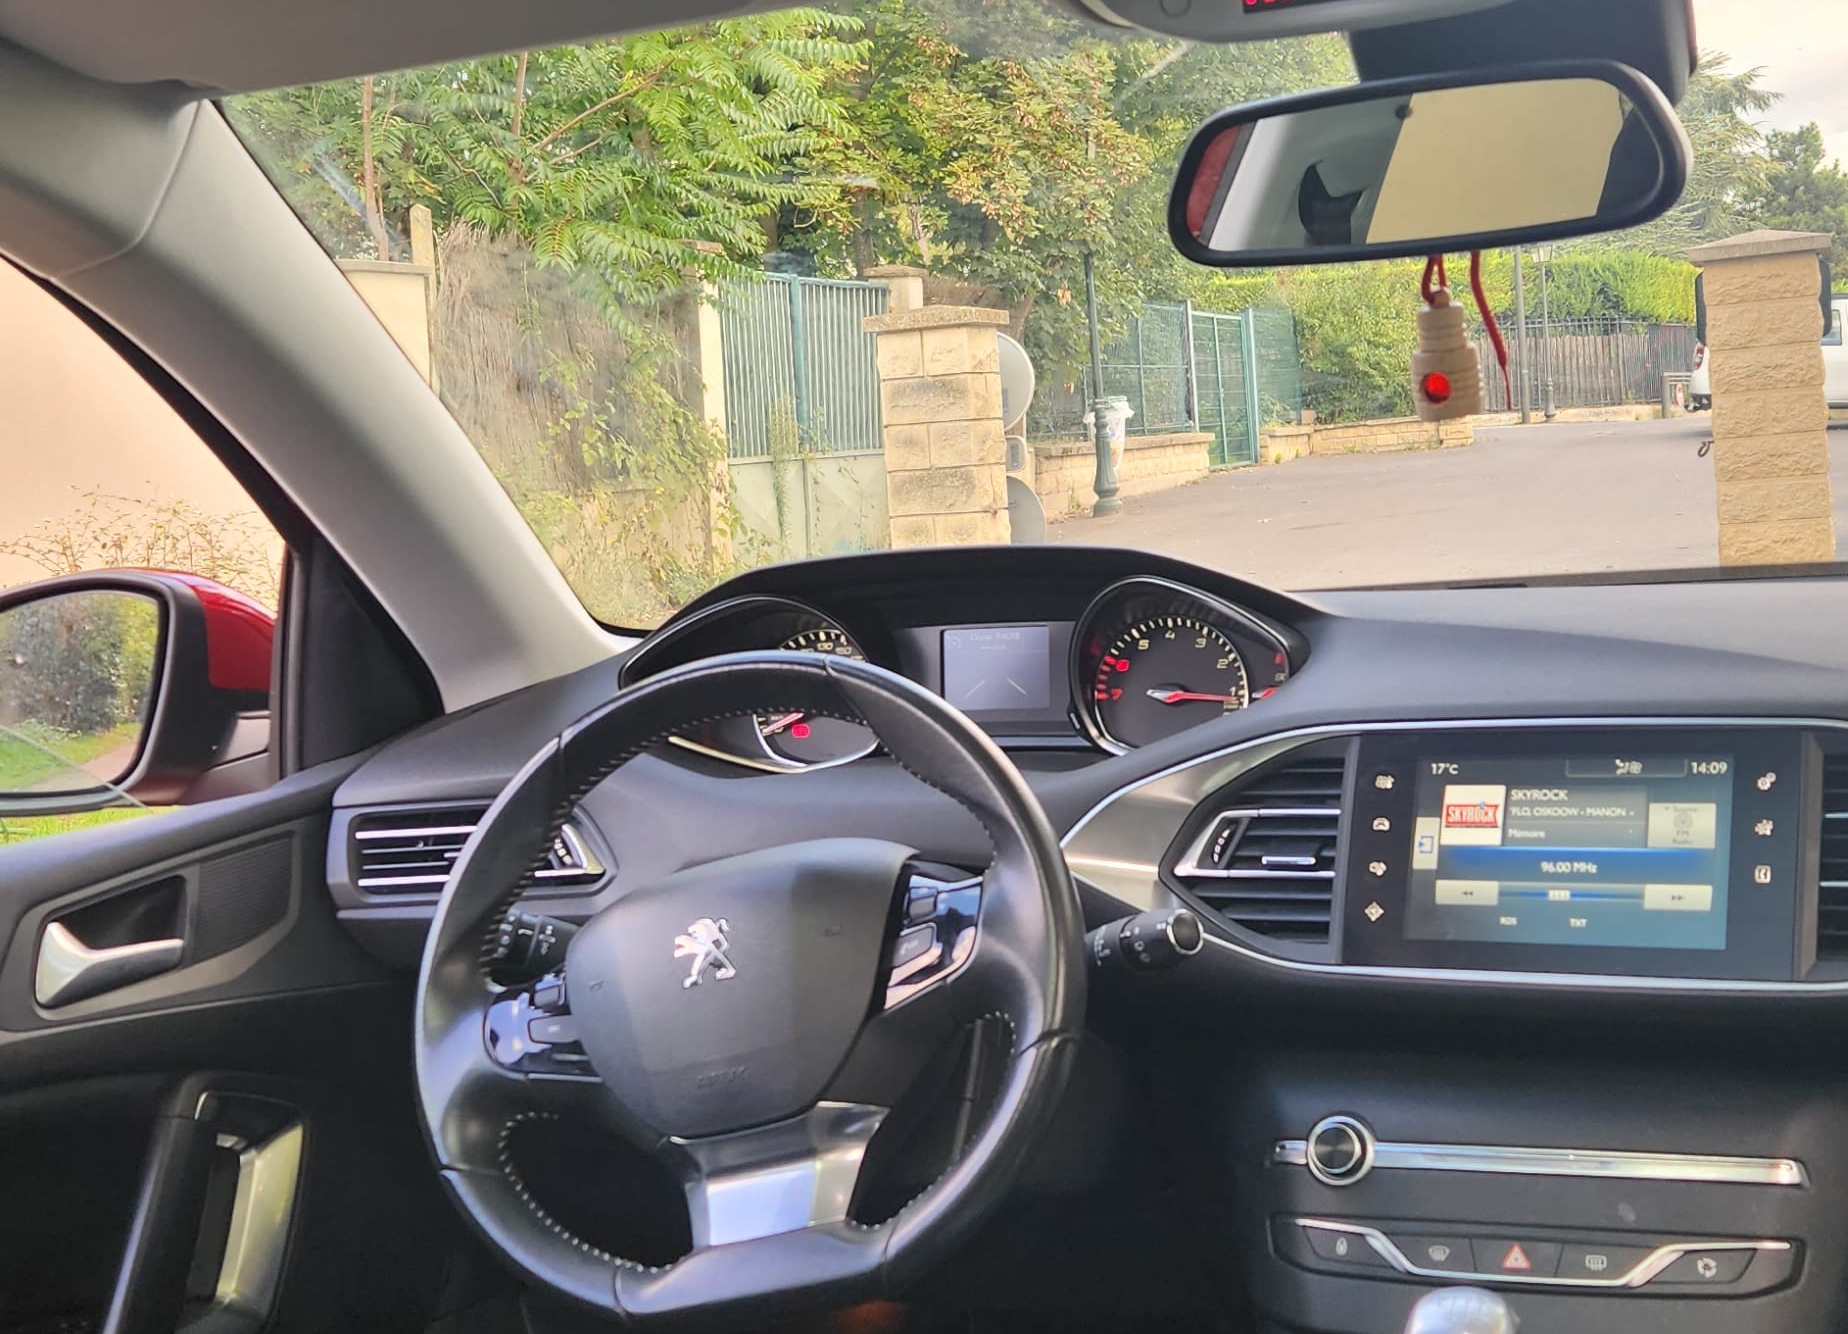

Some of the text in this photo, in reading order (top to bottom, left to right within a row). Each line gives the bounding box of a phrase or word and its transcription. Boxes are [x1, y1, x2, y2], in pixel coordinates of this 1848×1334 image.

[1164, 629, 1176, 640] 4
[1138, 638, 1150, 651] 5
[1195, 637, 1207, 648] 3
[1216, 658, 1229, 668] 2
[1229, 686, 1236, 696] 1
[1431, 763, 1458, 774] 17°C
[1691, 761, 1728, 774] 14:09
[1511, 789, 1568, 801] SKYROCK
[1447, 806, 1495, 823] SKYROCK
[1586, 806, 1627, 817] MANON
[1540, 861, 1598, 874] 96.00 MHz
